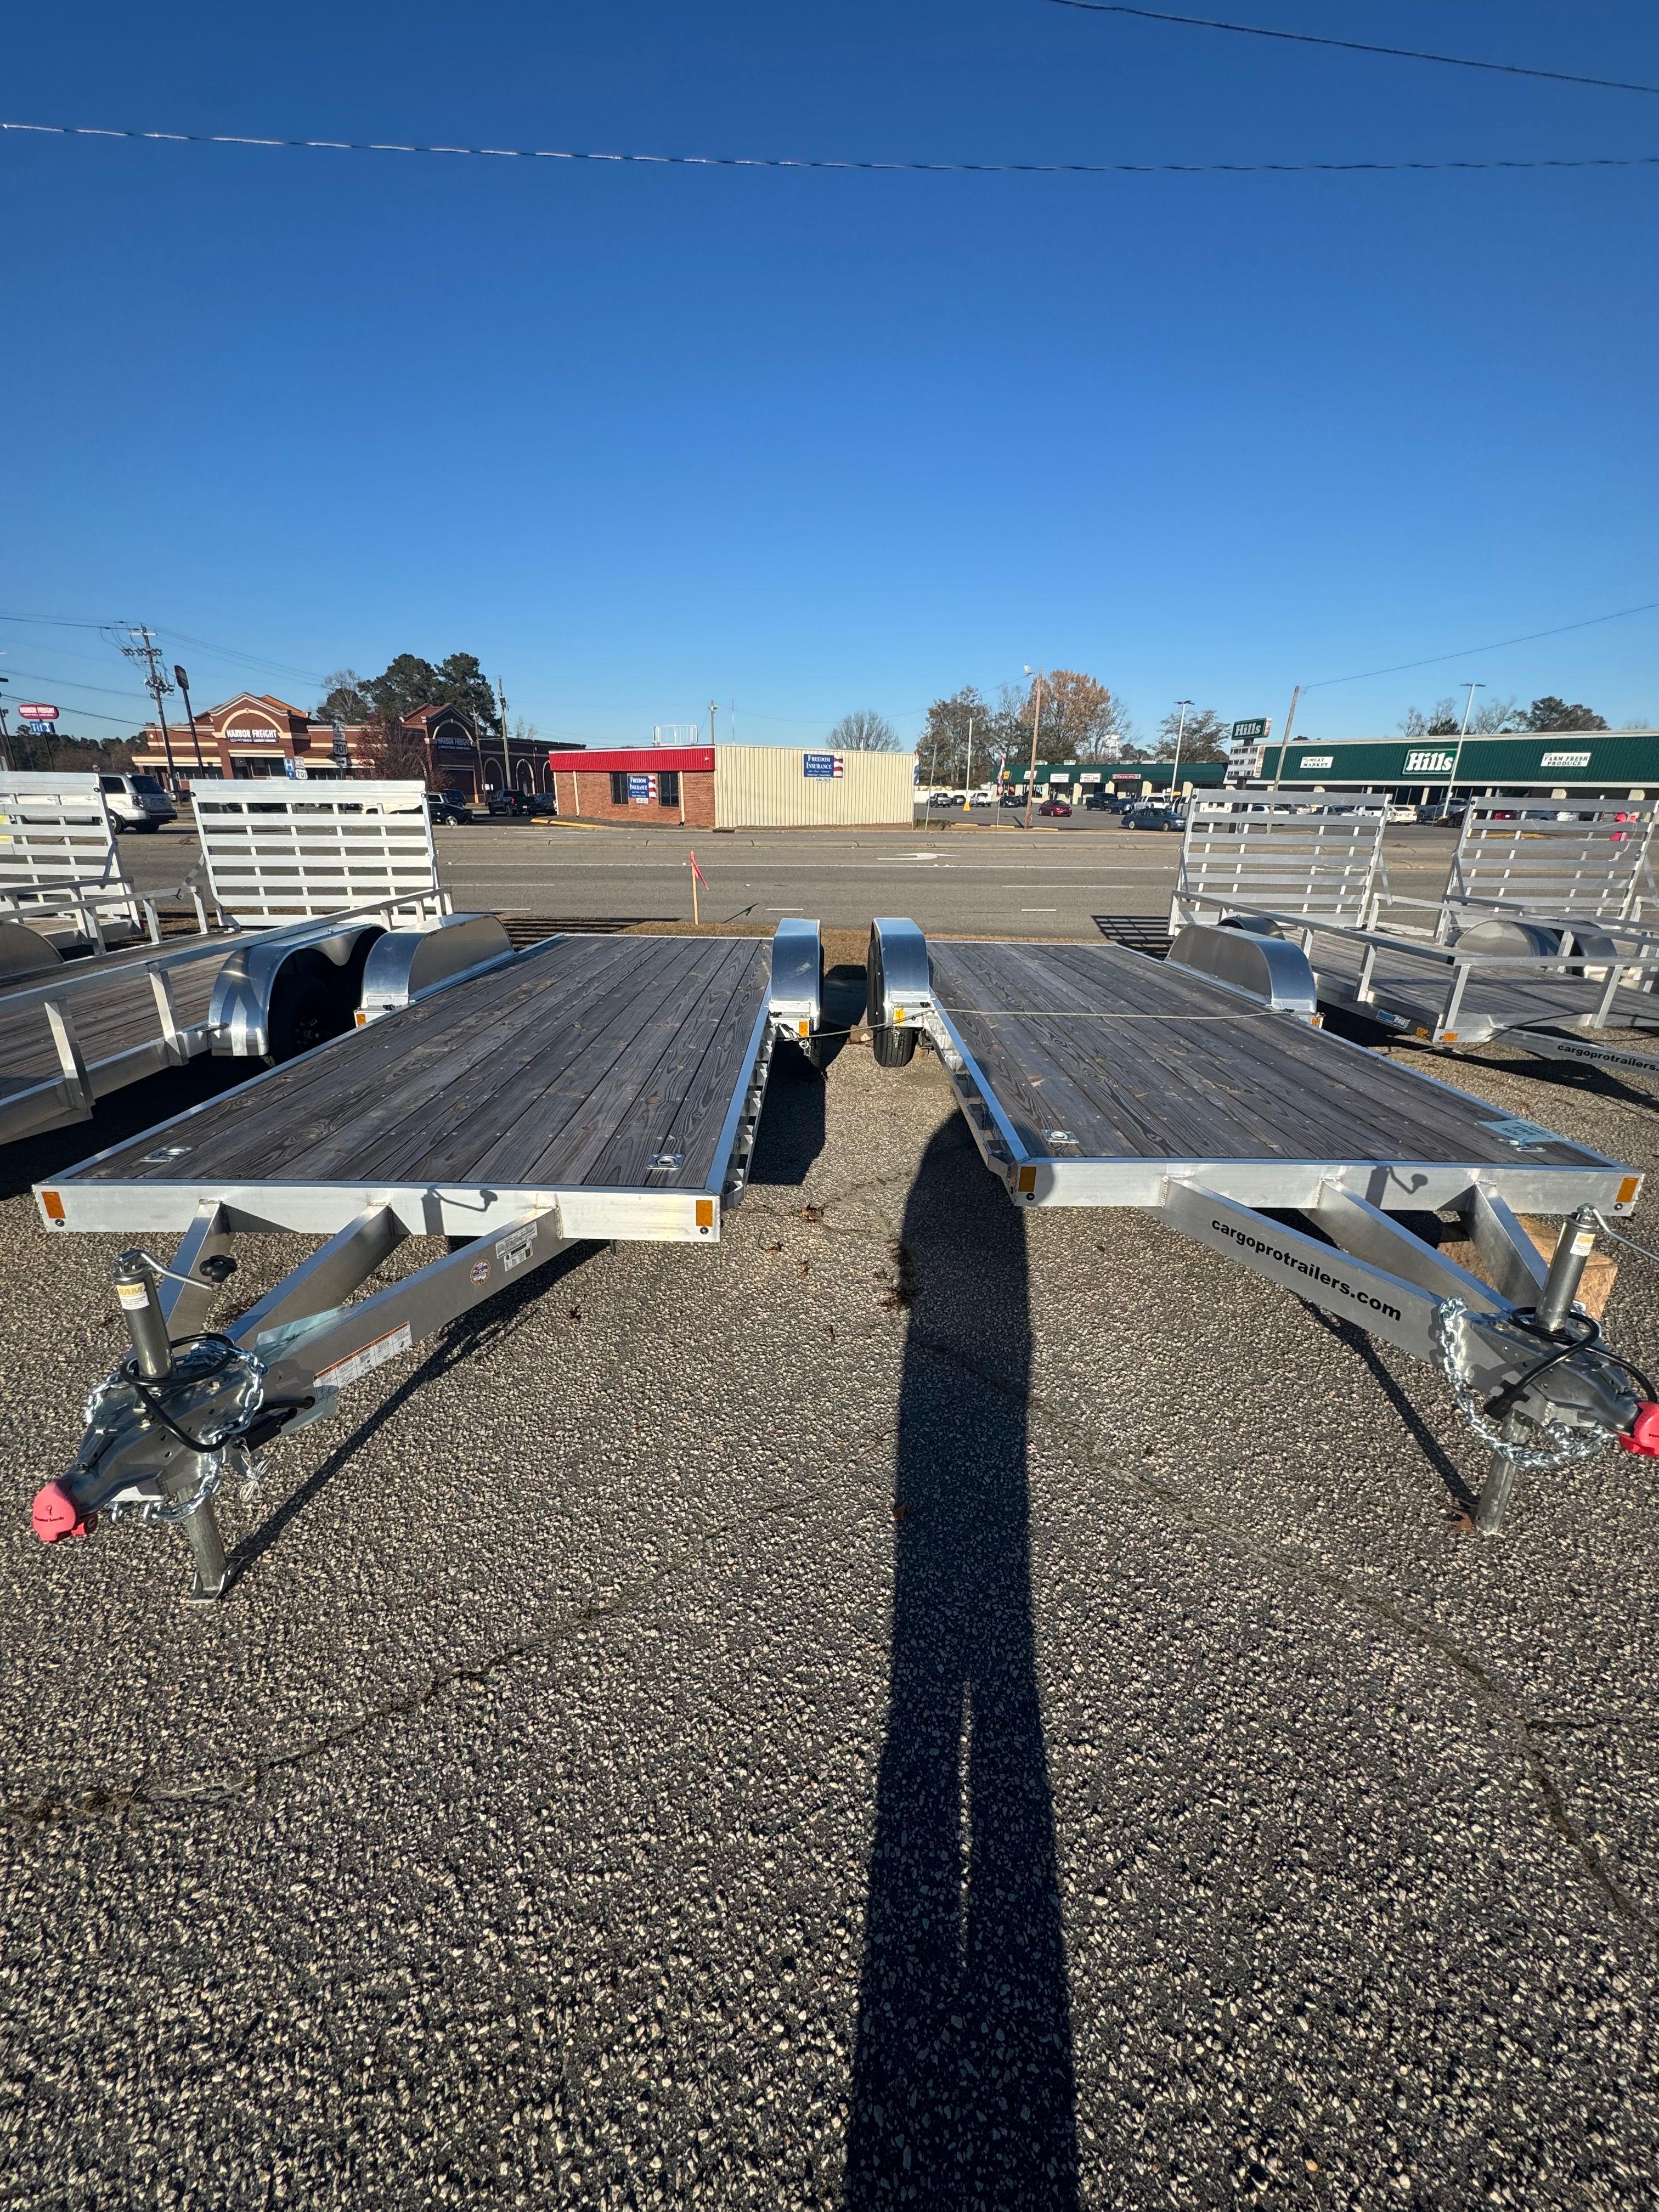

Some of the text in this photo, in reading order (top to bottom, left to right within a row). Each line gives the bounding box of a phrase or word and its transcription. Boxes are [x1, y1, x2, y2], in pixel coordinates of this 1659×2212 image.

[226, 729, 277, 738] HARBOR FREIGHT
[1234, 723, 1261, 736] Hills
[335, 744, 347, 753] 701
[806, 761, 832, 770] INSURANCE
[1406, 752, 1454, 771] Hills
[1023, 784, 1043, 795] TATOO
[1211, 1220, 1401, 1321] cargoprotrailers.com
